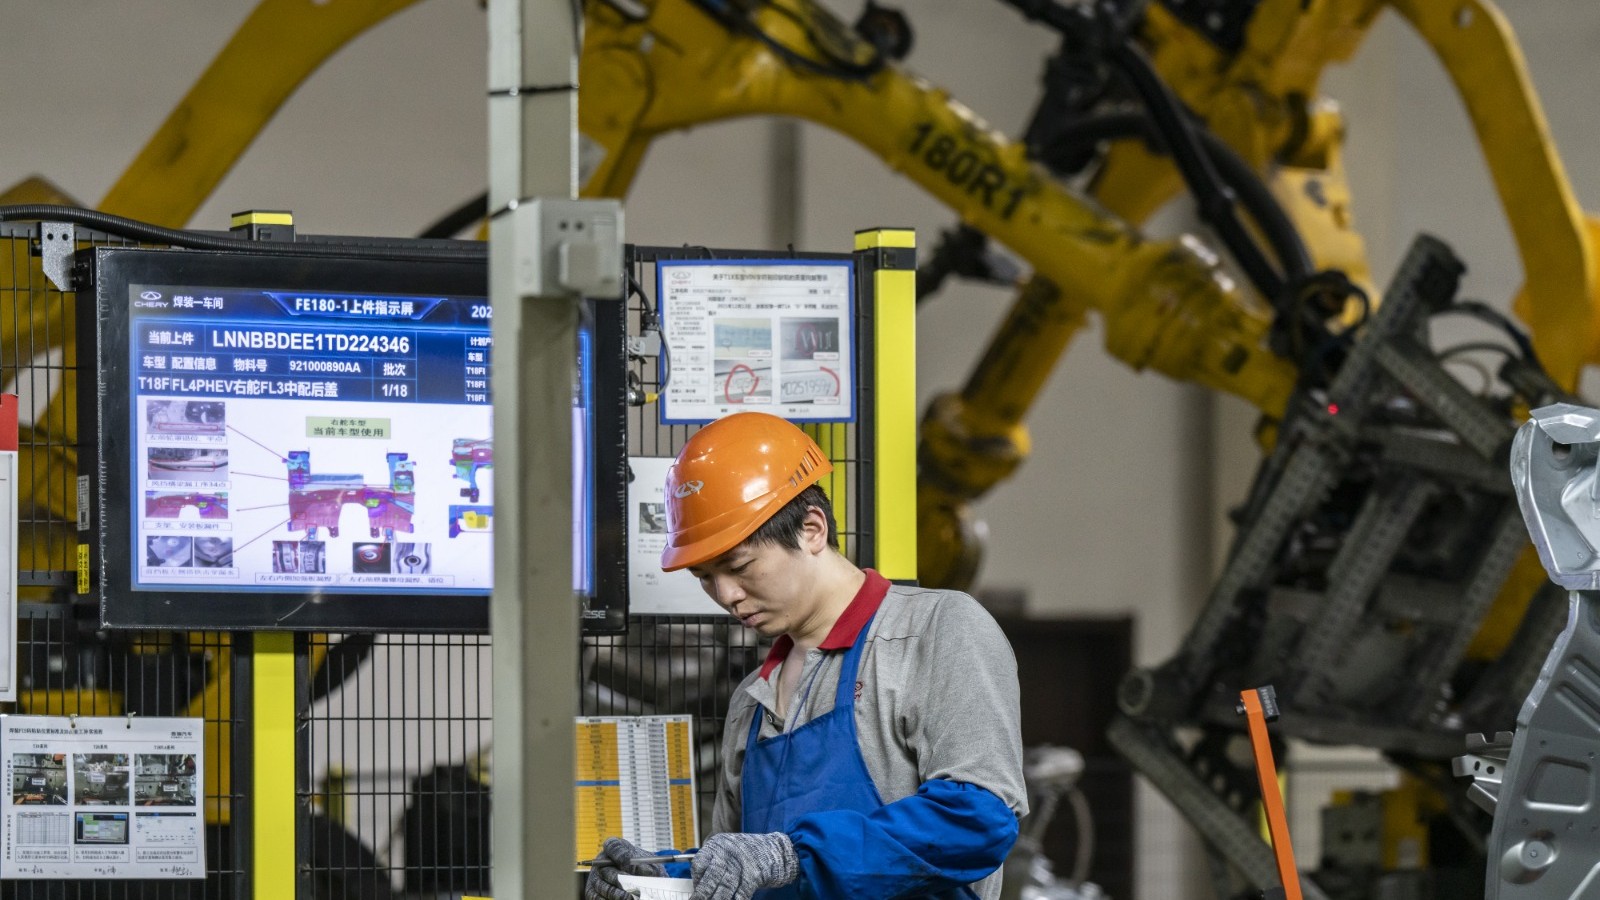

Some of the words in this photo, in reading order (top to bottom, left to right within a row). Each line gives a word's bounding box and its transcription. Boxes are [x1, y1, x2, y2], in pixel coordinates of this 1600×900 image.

[909, 122, 1026, 222] 180R1
[134, 301, 169, 309] CHERY
[173, 295, 224, 310] 焊装一车间
[295, 297, 414, 316] FE180-1上件指示屏
[471, 305, 493, 319] 202
[148, 331, 195, 346] 当前上件
[213, 329, 410, 354] LNNBBDEE1TD224346
[470, 336, 493, 347] 计划产
[142, 355, 166, 369] 车型
[171, 356, 217, 371] 配置信息
[467, 352, 483, 363] 车型
[233, 358, 268, 373] 物料号
[289, 360, 361, 374] 921000890AA
[383, 363, 406, 377] 批次
[381, 384, 408, 398] 1/18
[313, 426, 385, 438] 当前车型使用
